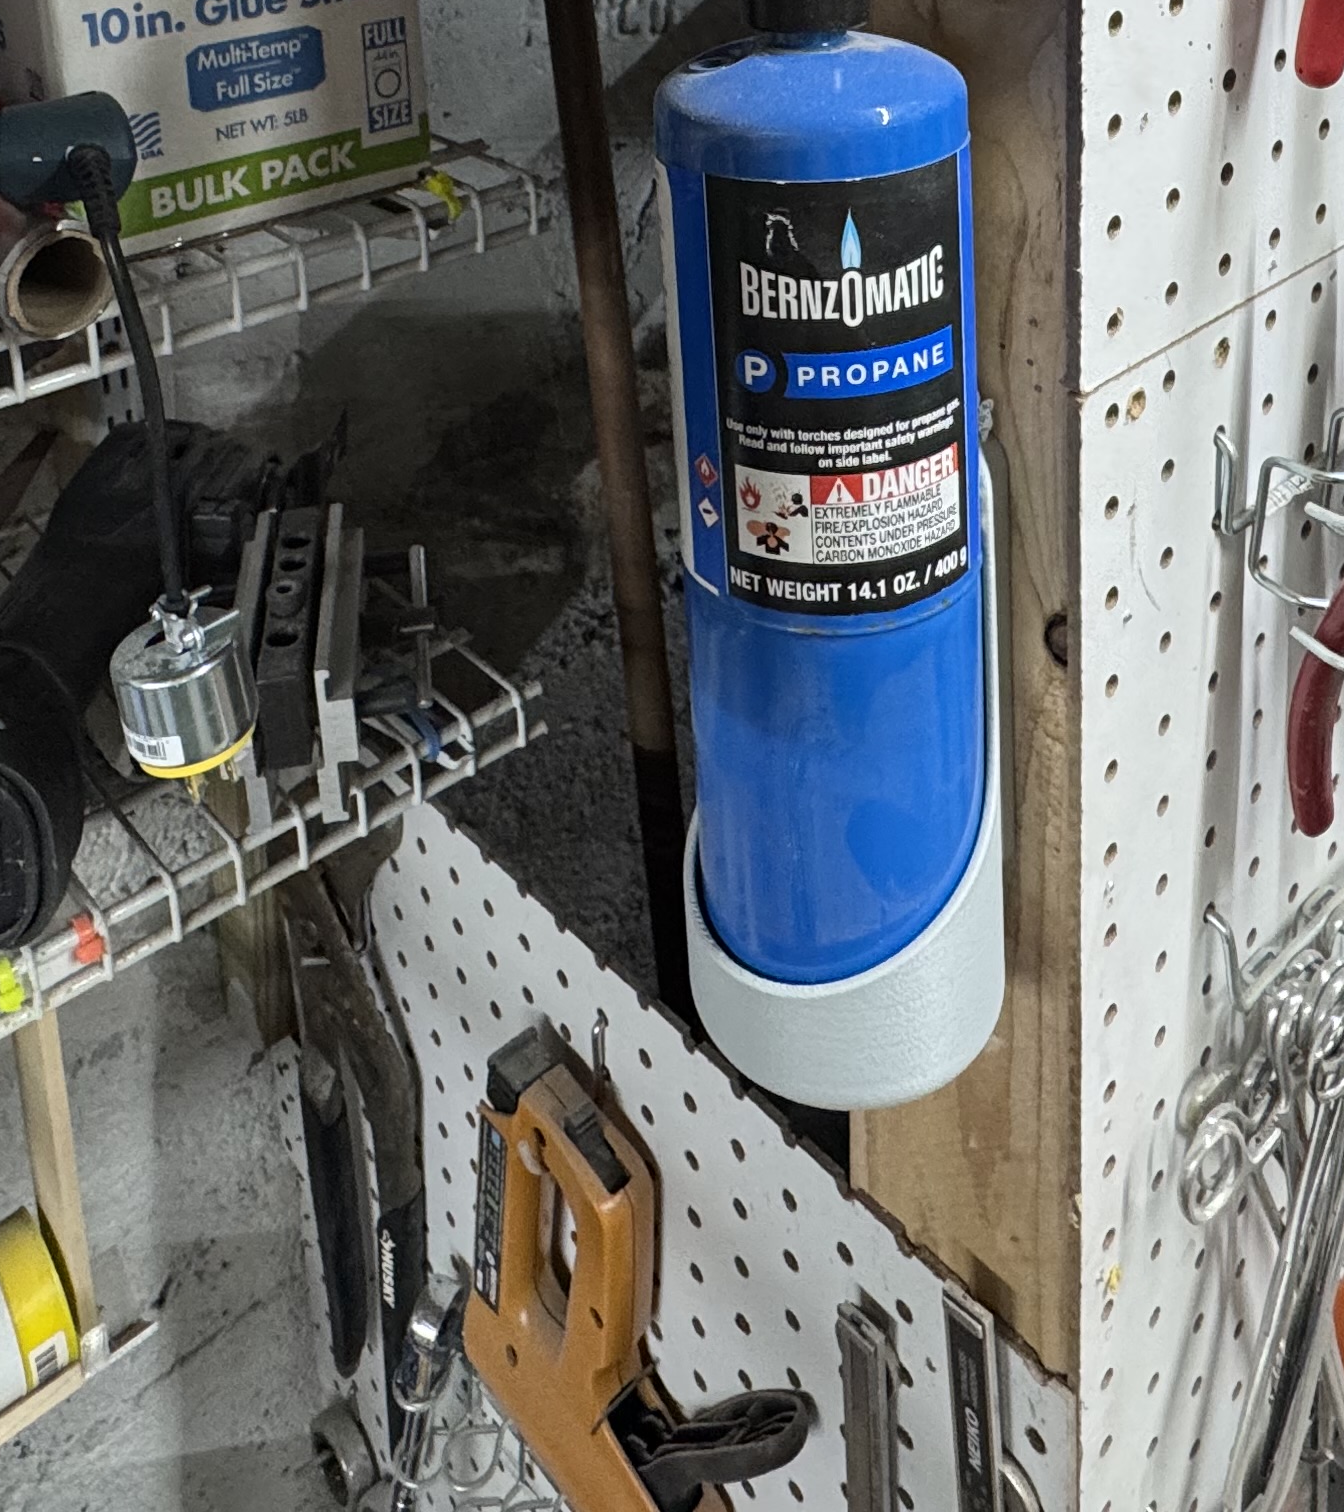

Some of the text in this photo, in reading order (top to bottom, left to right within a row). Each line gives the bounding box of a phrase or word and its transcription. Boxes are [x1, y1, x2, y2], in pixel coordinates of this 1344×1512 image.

[364, 19, 406, 48] FULL
[216, 78, 250, 101] Full
[216, 122, 247, 142] NET
[284, 108, 309, 127] 5LB
[370, 103, 411, 130] SIZE
[150, 140, 356, 219] BULK PACK
[739, 243, 944, 328] BERNZOMATIC
[744, 357, 769, 386] P
[797, 344, 945, 387] PROPANE
[726, 418, 743, 432] Use
[746, 422, 767, 438] only
[771, 427, 794, 439] with
[797, 429, 841, 442] torches
[843, 423, 893, 441] designed
[896, 419, 910, 431] for
[911, 406, 946, 430] propane
[739, 415, 953, 460] Read and follow important safety warnings
[818, 451, 892, 469] on side label.
[861, 445, 956, 502] DANGER
[814, 484, 941, 519] EXTREMELY FLAMMABLE
[815, 498, 943, 534] FIRE/EXPLOSION HAZARD
[815, 503, 958, 548] CONTENTS UNDER PRESSURE
[816, 520, 955, 563] CARBON MONOXIDE HAZARD
[730, 546, 967, 602] NET WEIGHT 14.1 OZ. / 400 g
[381, 1248, 397, 1309] HUSKY
[964, 1406, 982, 1475] NEIKO
